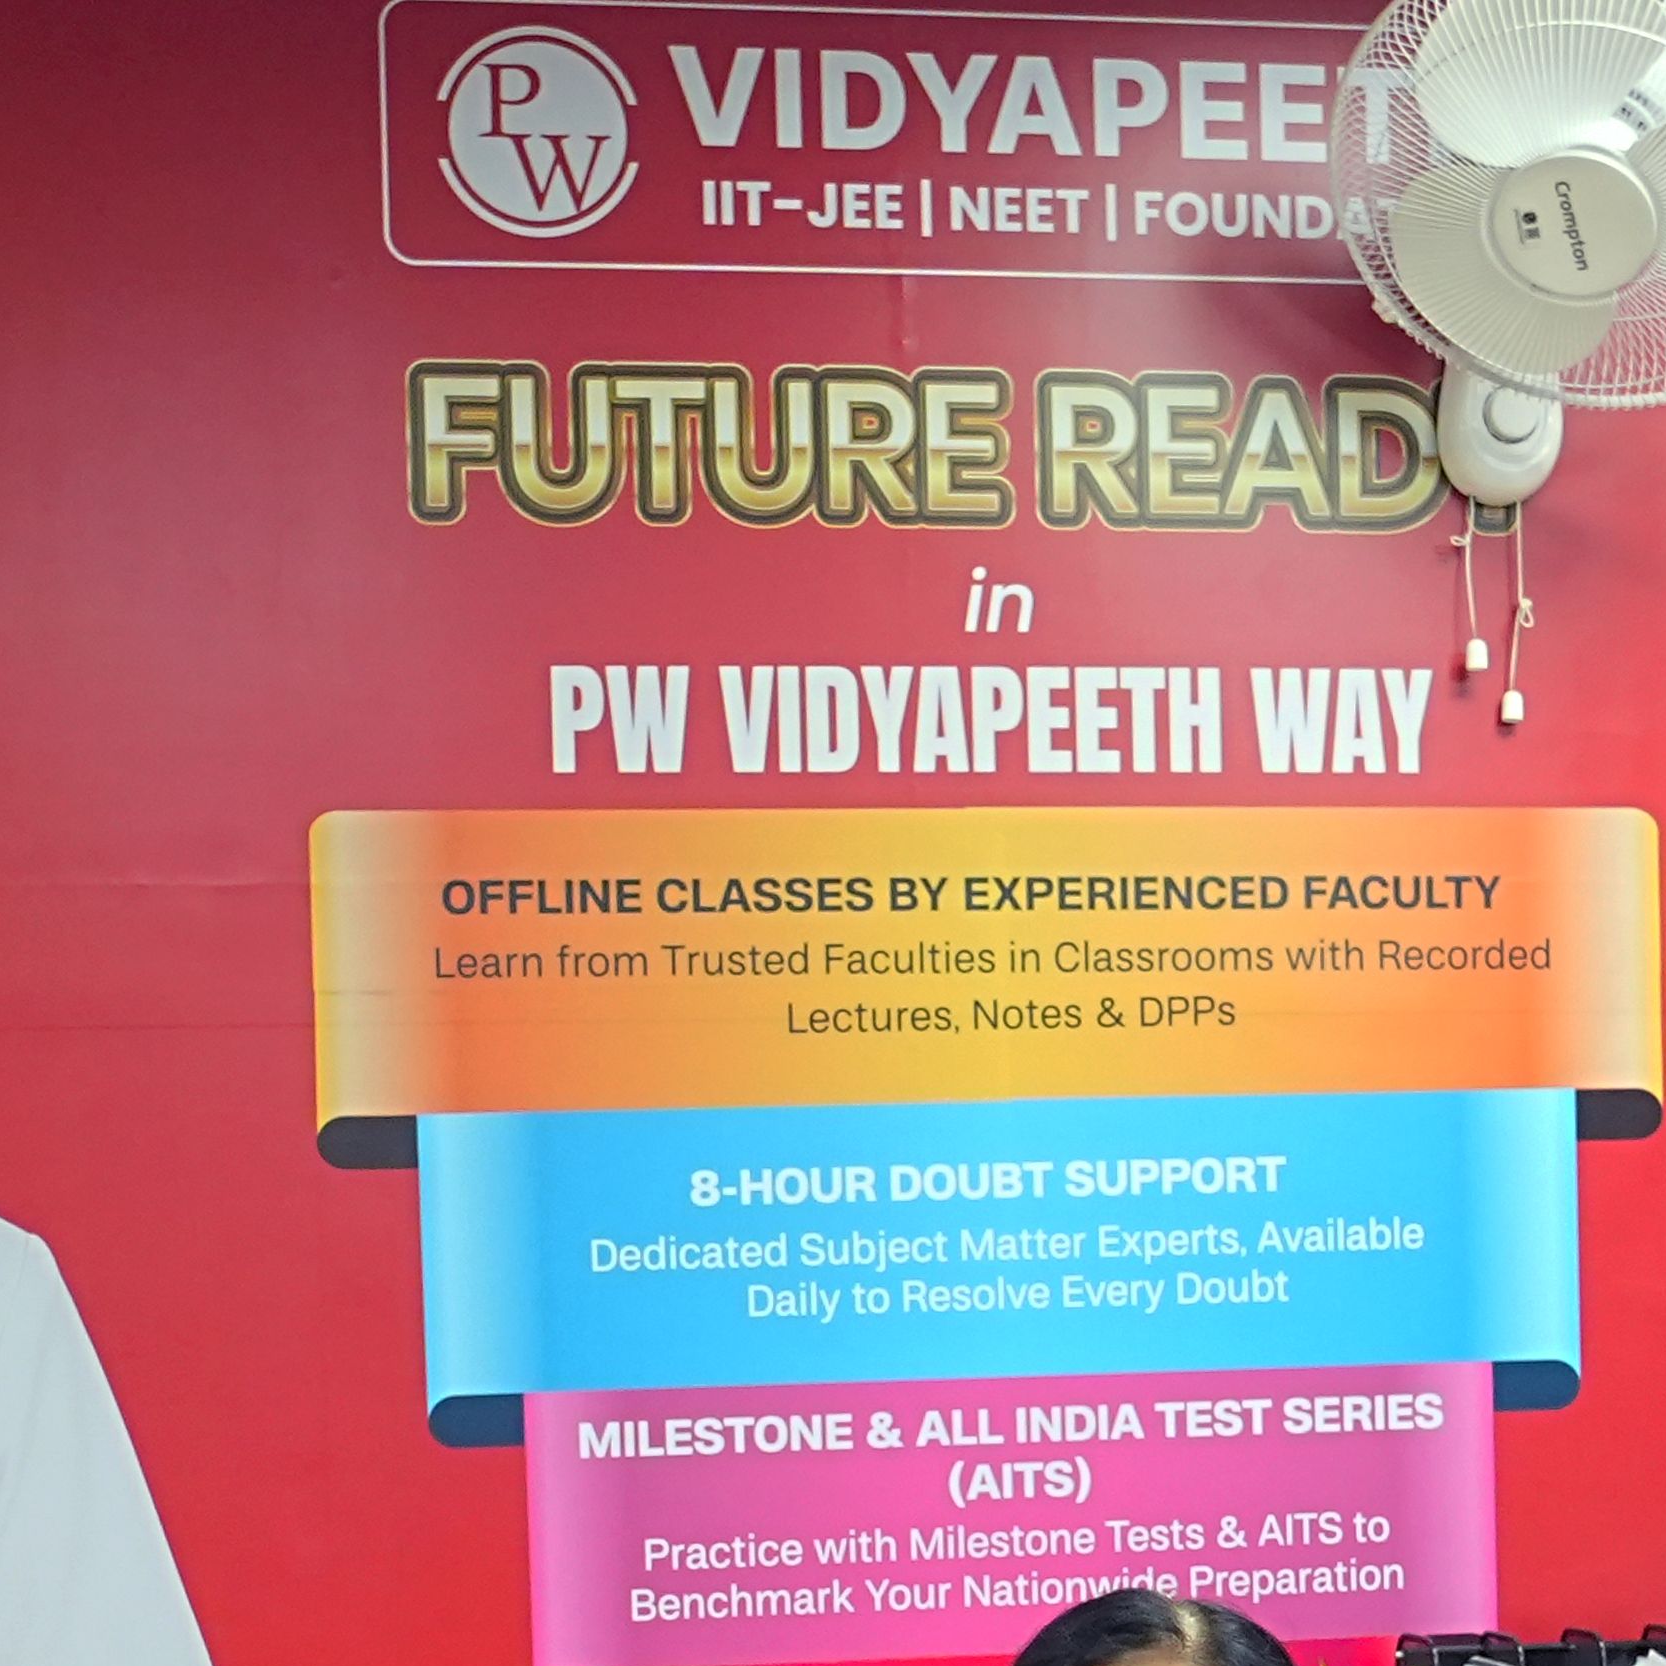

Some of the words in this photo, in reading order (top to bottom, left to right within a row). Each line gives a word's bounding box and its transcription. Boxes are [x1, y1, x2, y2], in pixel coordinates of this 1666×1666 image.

[667, 45, 1418, 165] VIDYAPEET
[702, 180, 903, 229] IIT-JEE
[949, 186, 1090, 234] NEET
[1135, 191, 1395, 242] FOUNDA
[1554, 180, 1589, 271] Crompton
[408, 360, 1015, 526] FUTURE
[1037, 368, 1520, 534] READ
[964, 566, 1035, 633] in
[549, 664, 690, 774] PW
[718, 664, 1222, 774] VIDYAPEETH
[1250, 667, 1432, 774] WAY
[442, 877, 642, 916] OFFLINE
[656, 876, 874, 914] CLASSES
[888, 876, 947, 912] BY
[964, 874, 1290, 912] EXPERIENCED
[1303, 873, 1502, 912] FACULTY
[434, 945, 543, 980] Learn
[557, 943, 649, 978] from
[660, 941, 810, 977] Trusted
[823, 940, 997, 976] Faculties
[1009, 940, 1041, 974] in
[1054, 939, 1273, 973] Classrooms
[1285, 938, 1366, 971] with
[1378, 937, 1552, 971] Recorded
[786, 1000, 962, 1037] Lectures,
[972, 997, 1083, 1031] Notes
[1095, 996, 1126, 1029] &
[1139, 994, 1237, 1028] DPPs
[689, 1166, 876, 1207] 8-HOUR
[889, 1161, 1053, 1203] DOUBT
[1064, 1155, 1287, 1199] SUPPORT
[589, 1232, 788, 1273] Dedicated
[799, 1229, 948, 1274] Subject
[960, 1226, 1087, 1264] Matter
[1098, 1220, 1249, 1265] Experts,
[1257, 1215, 1425, 1255] Available
[747, 1281, 837, 1326] Daily
[851, 1281, 891, 1315] to
[902, 1274, 1051, 1313] Resolve
[1061, 1275, 1165, 1315] Every
[1175, 1269, 1290, 1306] Doubt
[578, 1413, 854, 1461] MILESTONE
[866, 1411, 903, 1449] &
[916, 1407, 1005, 1448] ALL
[1016, 1403, 1145, 1444] INDIA
[1154, 1398, 1273, 1440] TEST
[1282, 1393, 1444, 1435] SERIES
[948, 1455, 1093, 1508] (AITS)
[643, 1532, 804, 1572] Practice
[814, 1528, 898, 1566] with
[909, 1523, 1096, 1563] Milestone
[1105, 1516, 1205, 1554] Tests
[1216, 1515, 1247, 1550] &
[1258, 1511, 1342, 1547] AITS
[1353, 1512, 1391, 1544] to
[630, 1581, 855, 1623] Benchmark
[865, 1577, 951, 1613] Your
[962, 1567, 1179, 1608] Nationwide
[1189, 1560, 1405, 1604] Preparation
